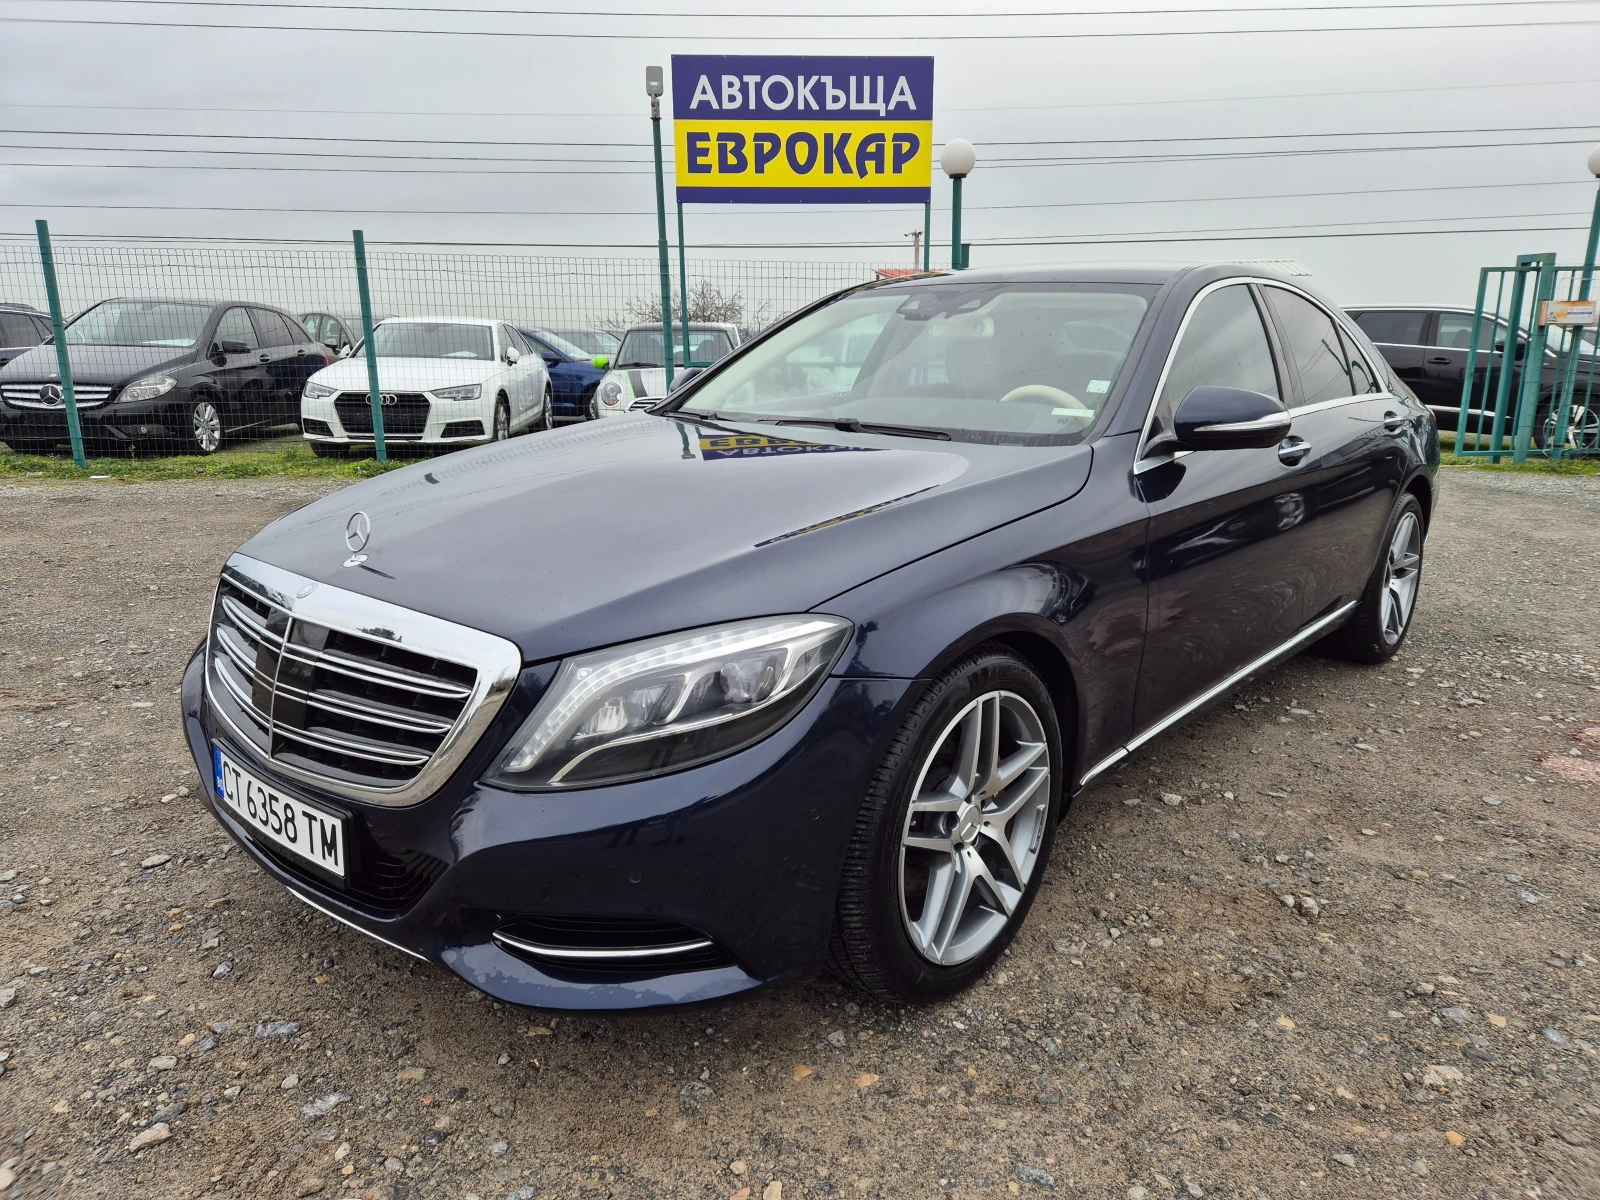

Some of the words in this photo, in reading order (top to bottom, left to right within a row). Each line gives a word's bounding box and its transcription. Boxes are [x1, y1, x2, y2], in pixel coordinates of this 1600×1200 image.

[690, 74, 917, 117] АВТОКЪЩА
[686, 131, 921, 179] ЕВРОКАР
[223, 760, 241, 808] CT
[246, 779, 298, 844] 6358
[301, 809, 339, 867] TM
